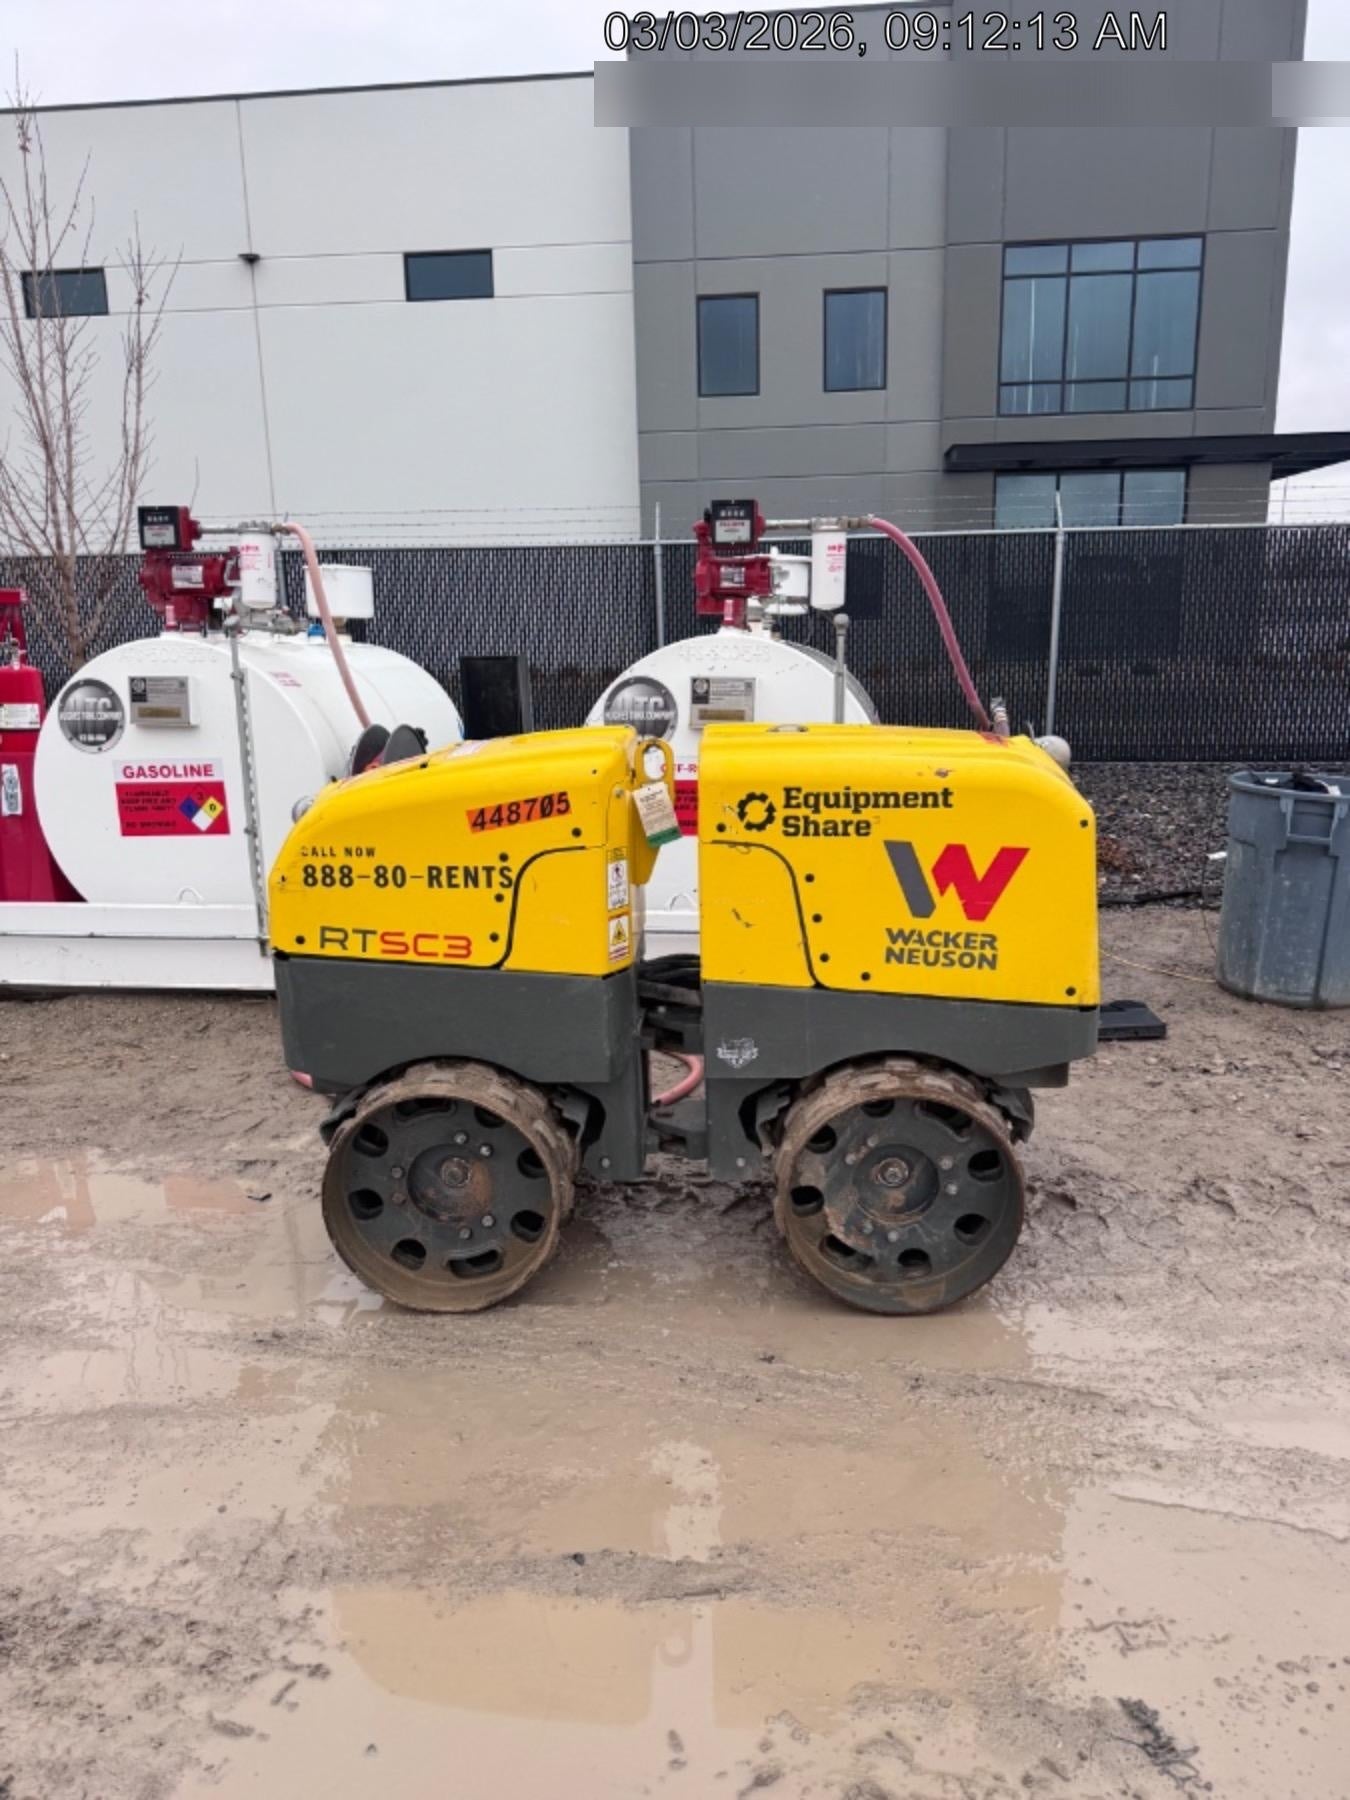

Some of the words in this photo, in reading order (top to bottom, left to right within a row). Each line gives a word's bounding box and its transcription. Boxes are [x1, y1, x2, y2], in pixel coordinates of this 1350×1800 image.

[122, 763, 215, 779] GASOLINE
[471, 791, 571, 832] 448705
[783, 786, 954, 815] Equipment
[782, 815, 872, 837] Share
[301, 846, 337, 857] CALL
[344, 847, 376, 857] NOW
[302, 864, 514, 889] 888-80-RENTS
[320, 925, 473, 959] RTSC3
[885, 927, 999, 951] WACKER
[885, 947, 998, 970] NEUSON
